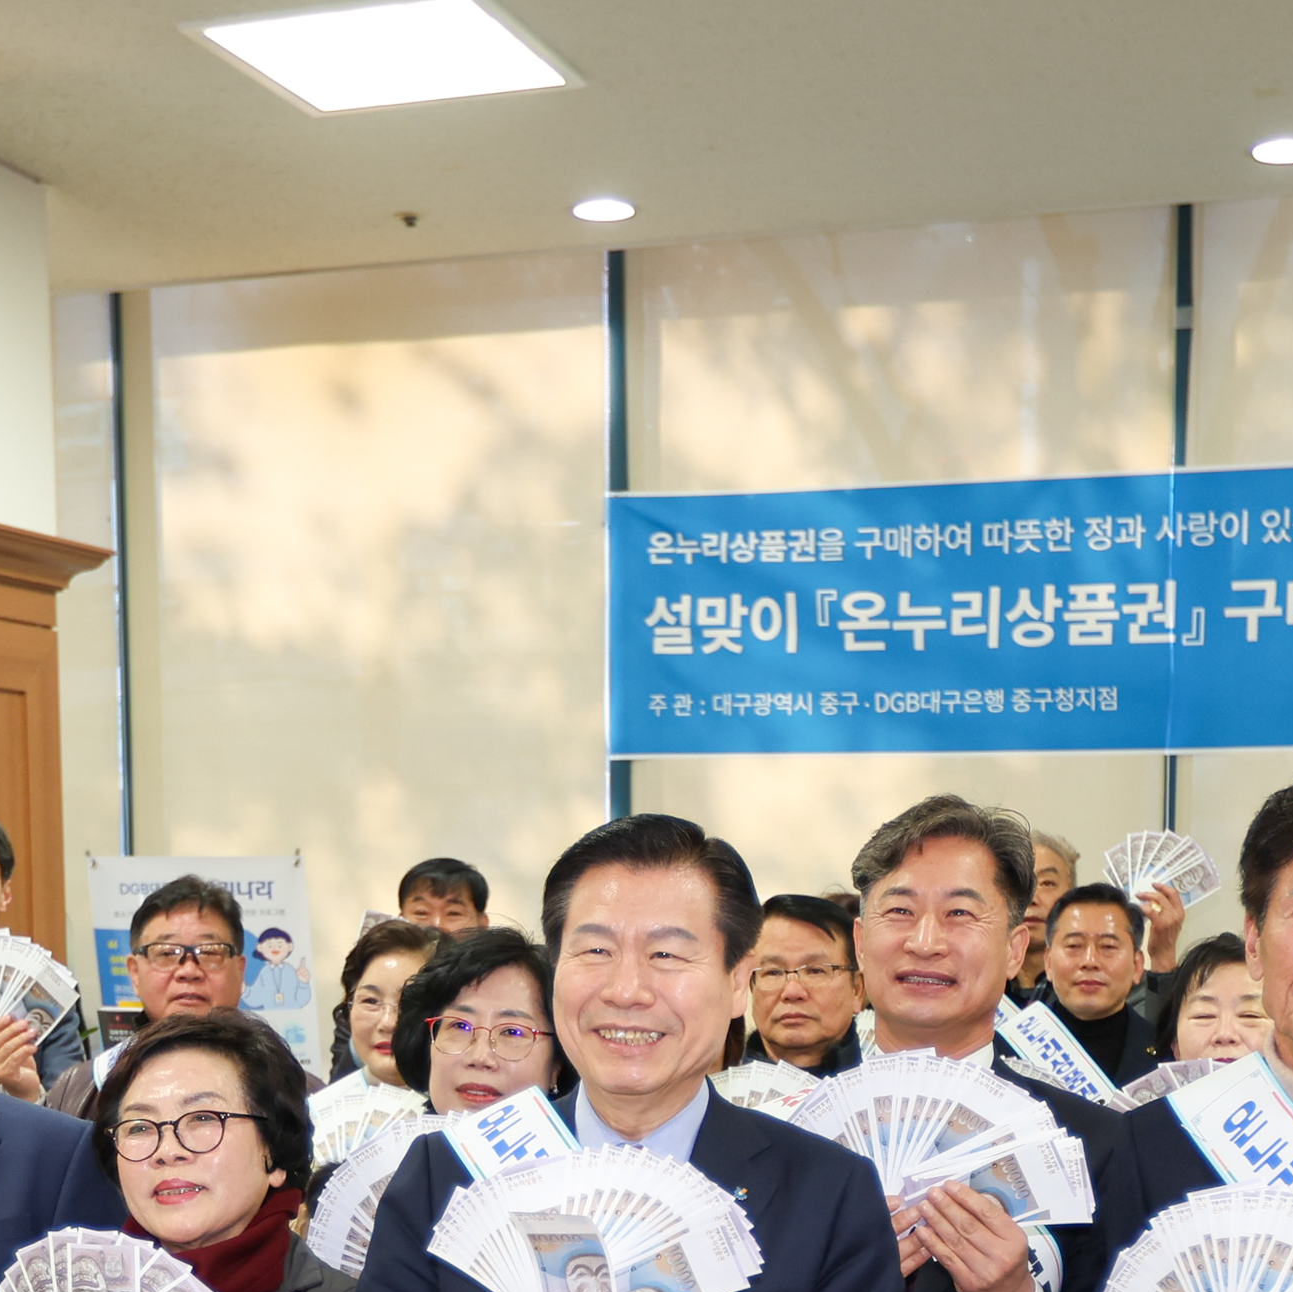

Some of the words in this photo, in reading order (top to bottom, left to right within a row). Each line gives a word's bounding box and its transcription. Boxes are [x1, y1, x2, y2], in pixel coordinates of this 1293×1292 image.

[647, 528, 846, 564] 온누리상품권을
[854, 521, 972, 560] 구매하여
[982, 517, 1074, 554] 따뜻한
[1084, 514, 1146, 551] 정과
[1155, 508, 1250, 547] 사랑이
[645, 591, 798, 654] 설맞이
[711, 691, 813, 716] 대구광역시
[1011, 685, 1118, 713] 중구청지점
[1004, 1155, 1031, 1199] 10000
[665, 1243, 697, 1292] 10000
